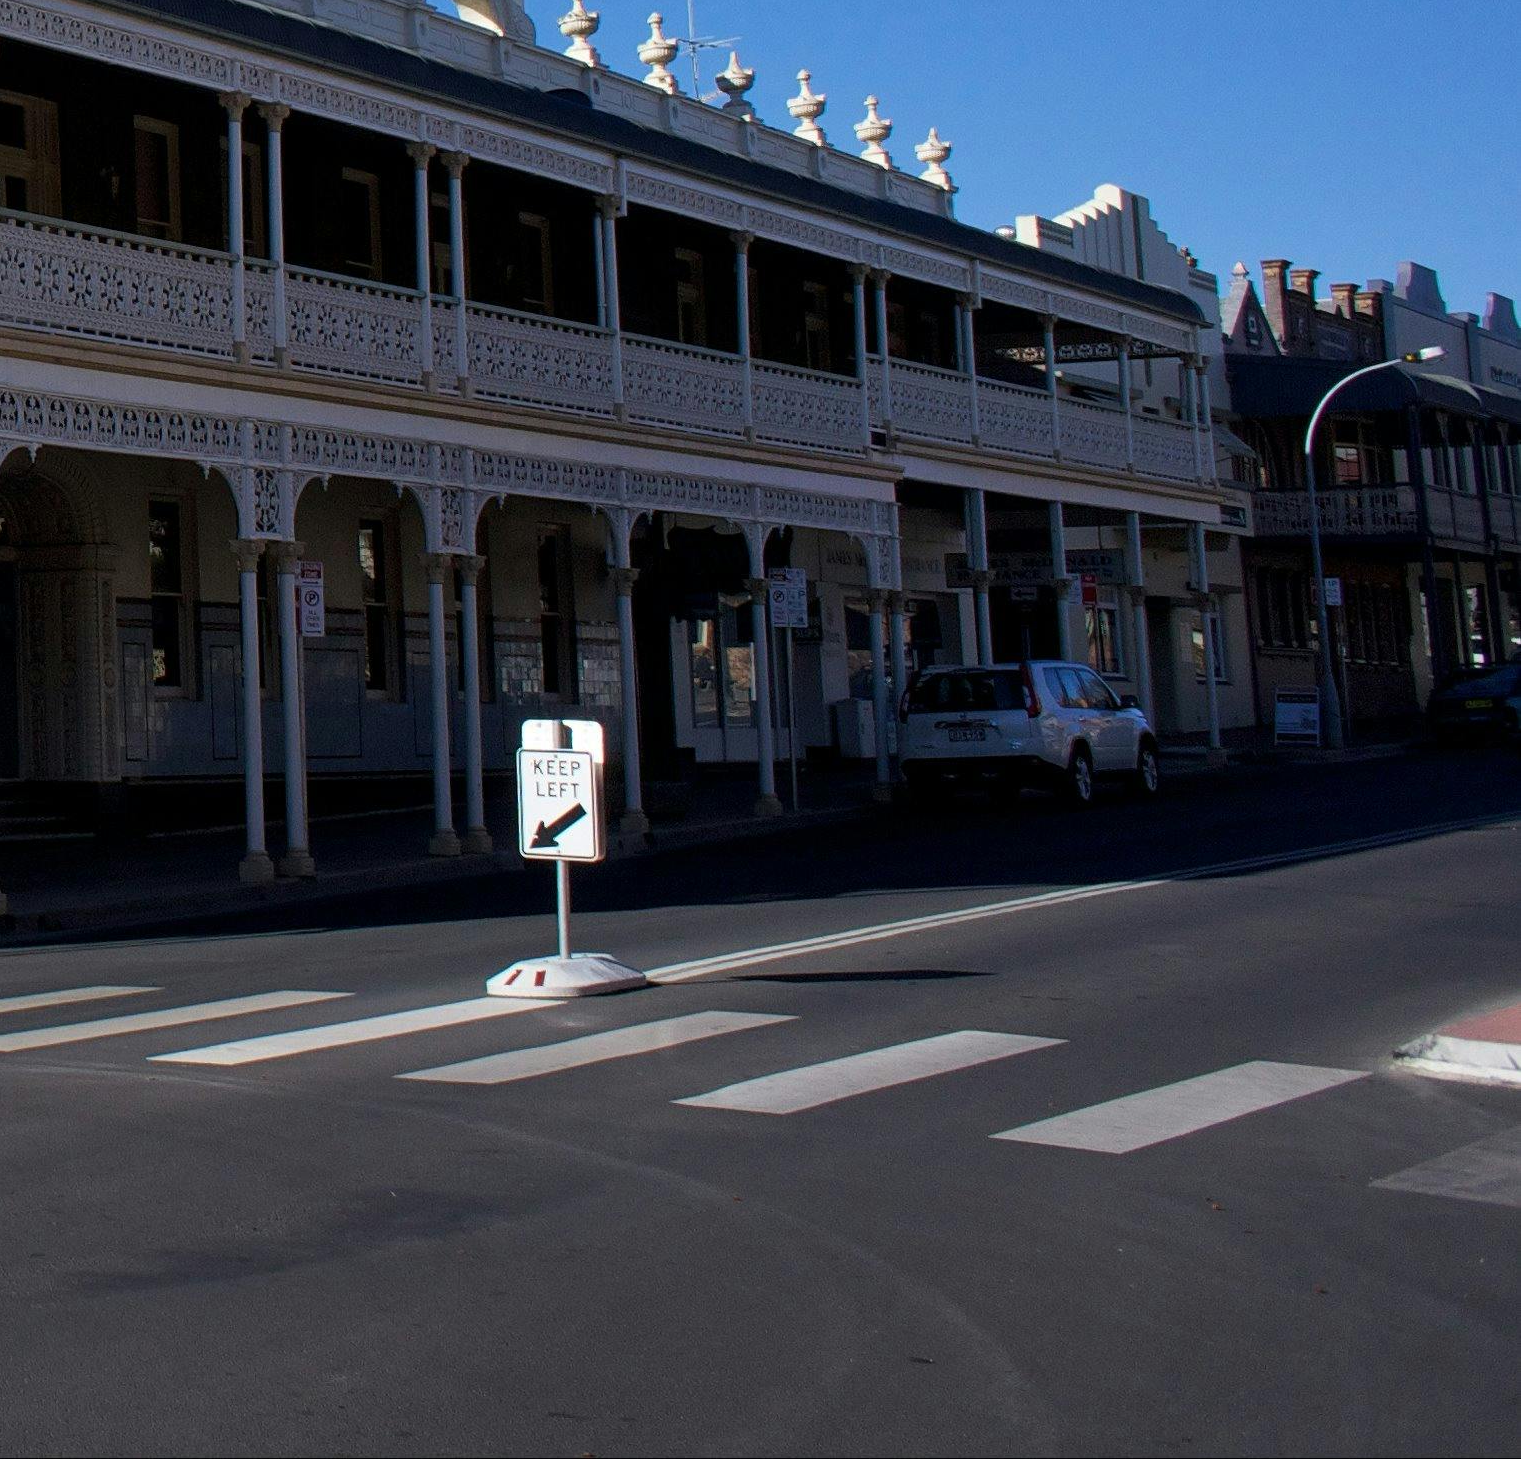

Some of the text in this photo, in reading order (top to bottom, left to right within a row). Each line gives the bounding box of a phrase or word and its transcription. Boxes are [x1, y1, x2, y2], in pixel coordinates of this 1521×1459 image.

[1022, 555, 1112, 568] McDNALD
[533, 759, 581, 777] KEEP
[536, 781, 580, 798] LEFT
